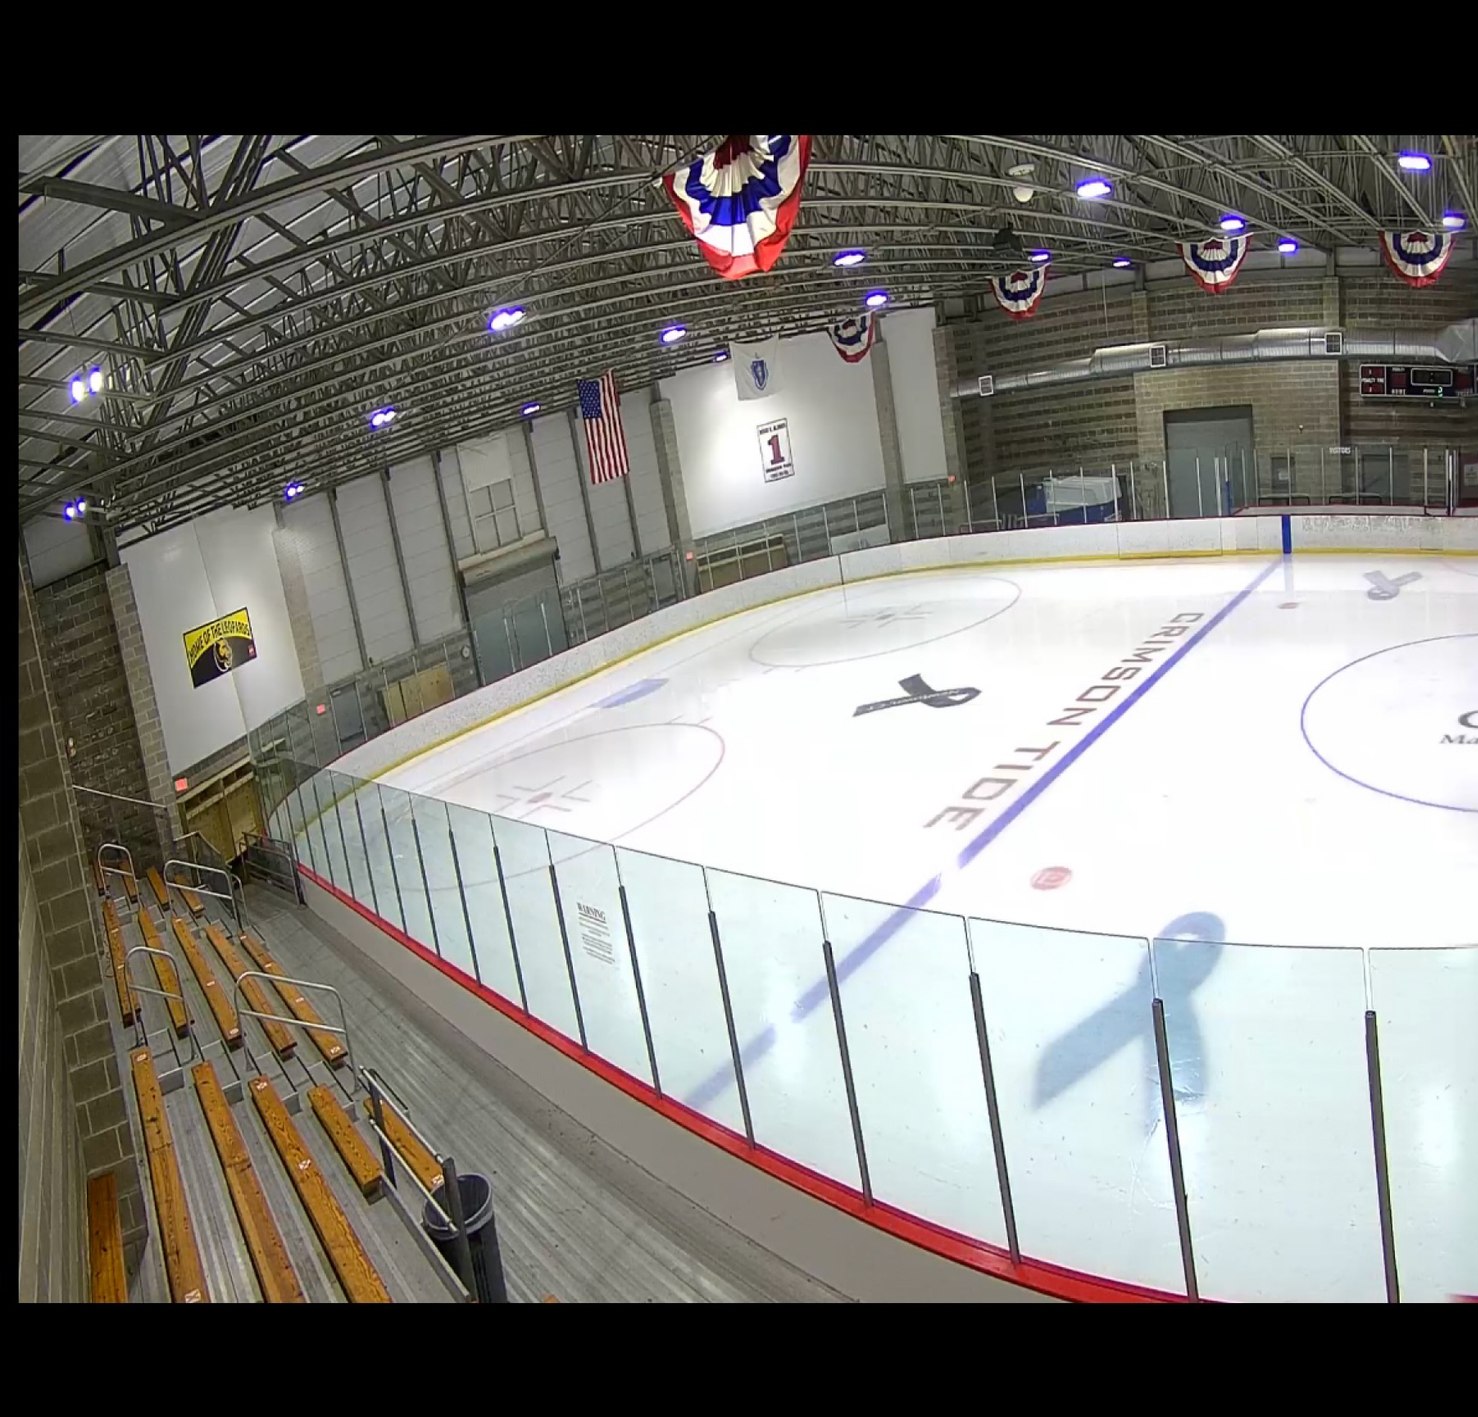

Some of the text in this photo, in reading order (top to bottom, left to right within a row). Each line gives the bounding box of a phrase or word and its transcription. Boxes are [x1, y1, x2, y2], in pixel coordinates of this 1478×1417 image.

[767, 434, 785, 465] 1
[922, 612, 1204, 832] CRIMSON TIDE
